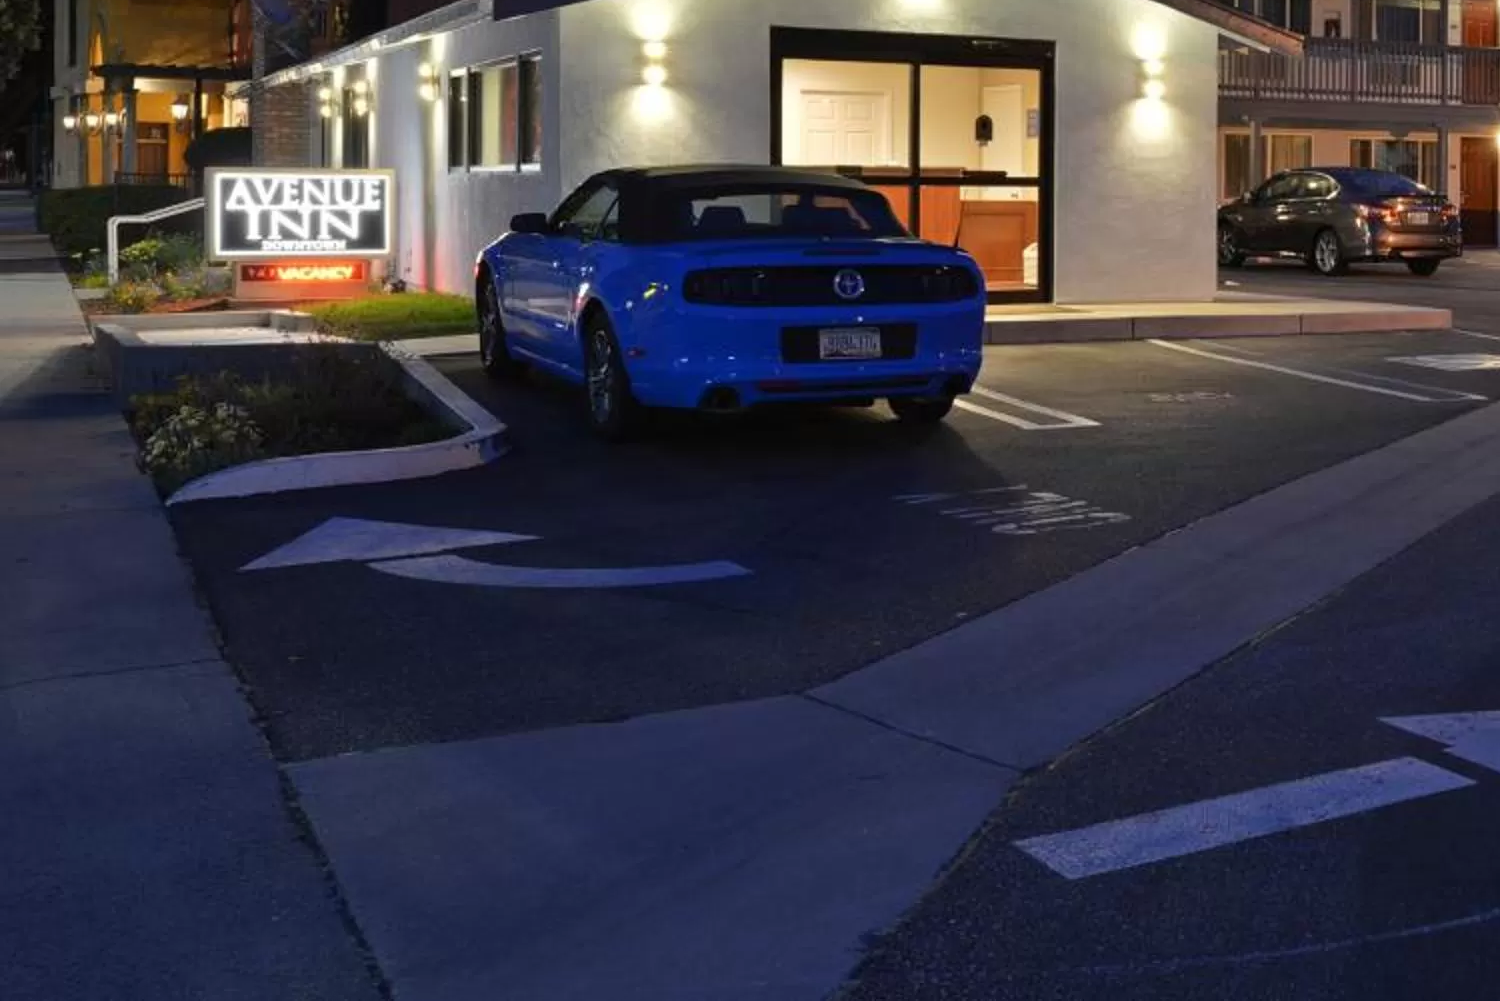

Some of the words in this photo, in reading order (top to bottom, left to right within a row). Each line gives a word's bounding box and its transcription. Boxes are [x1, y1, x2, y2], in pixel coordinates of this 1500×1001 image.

[226, 178, 381, 210] AVENUE
[246, 207, 362, 240] INN
[277, 266, 353, 280] VACANCY
